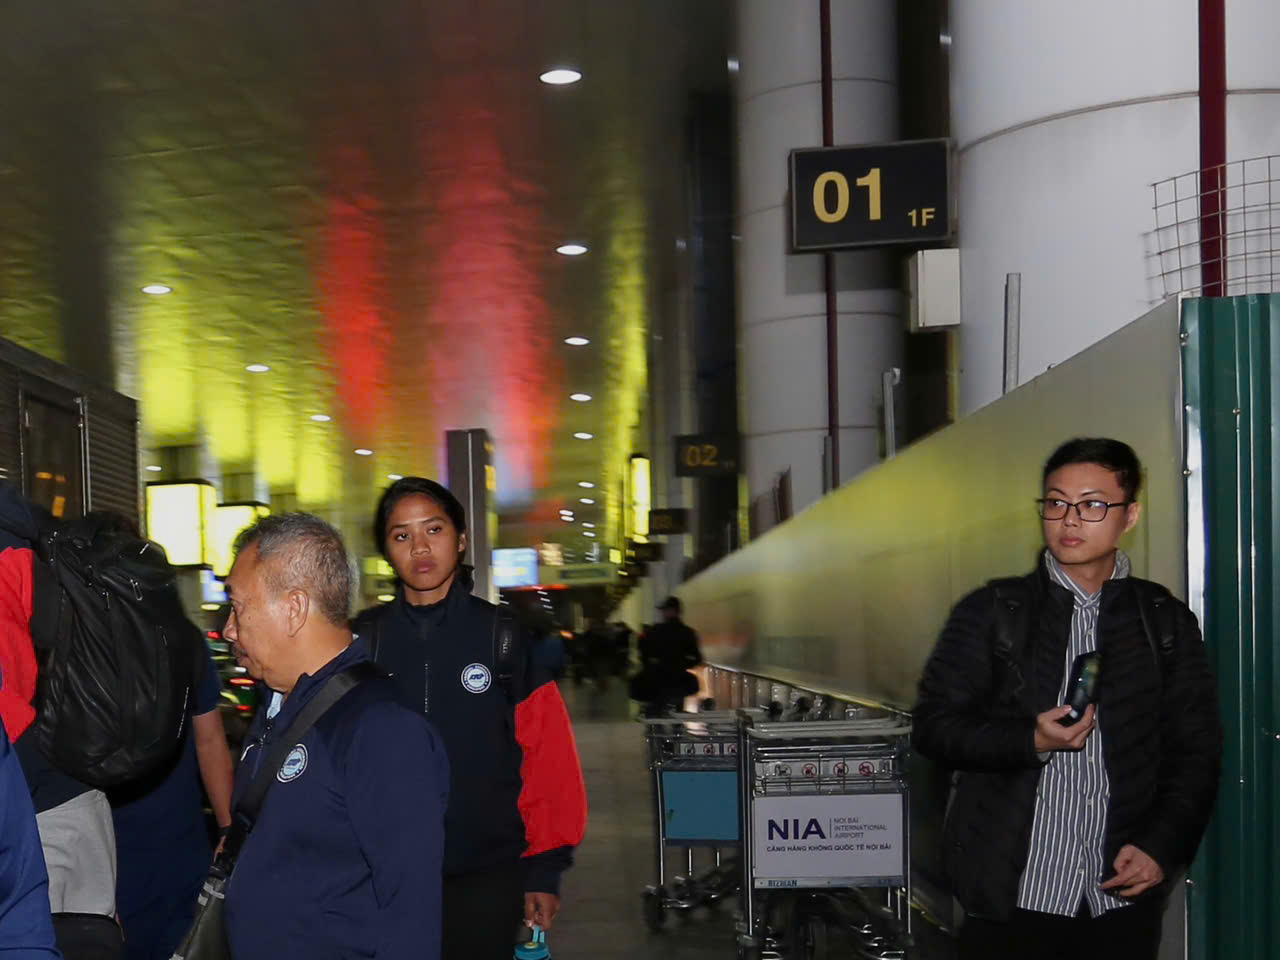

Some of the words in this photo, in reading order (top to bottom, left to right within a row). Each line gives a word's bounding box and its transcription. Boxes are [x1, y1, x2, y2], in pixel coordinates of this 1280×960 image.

[812, 167, 881, 223] 01
[907, 207, 936, 227] 1F
[684, 444, 718, 467] 02
[767, 818, 826, 840] NIA
